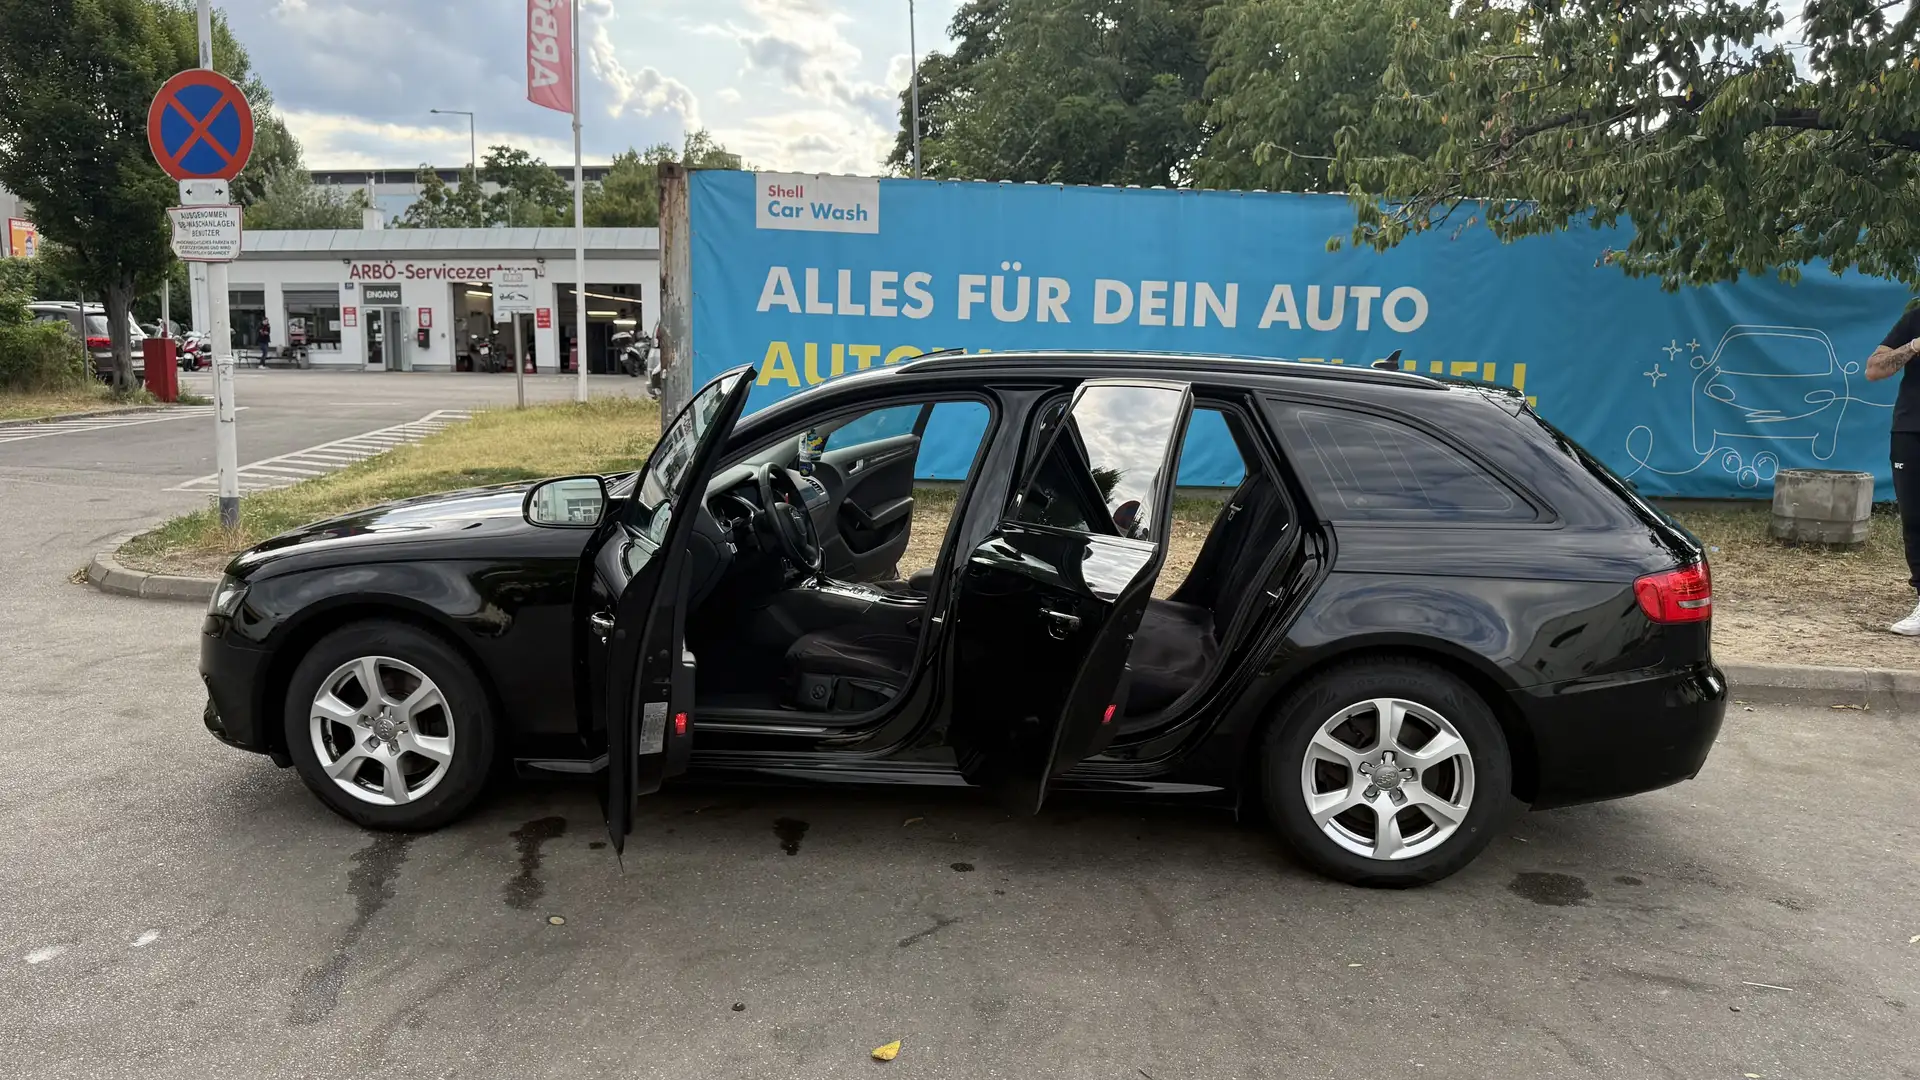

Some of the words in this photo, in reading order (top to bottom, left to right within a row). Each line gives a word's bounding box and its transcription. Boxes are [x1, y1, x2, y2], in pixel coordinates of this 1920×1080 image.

[768, 184, 804, 199] Shell
[180, 211, 228, 219] AUSGENOMMEN
[768, 200, 804, 218] Car
[810, 202, 868, 221] Wash
[191, 229, 220, 237] BENUTZER
[366, 290, 399, 299] EINGANG
[756, 266, 934, 319] ALLES
[957, 260, 1071, 323] FÜR
[1093, 279, 1239, 328] DEIN
[1257, 284, 1429, 333] AUTO
